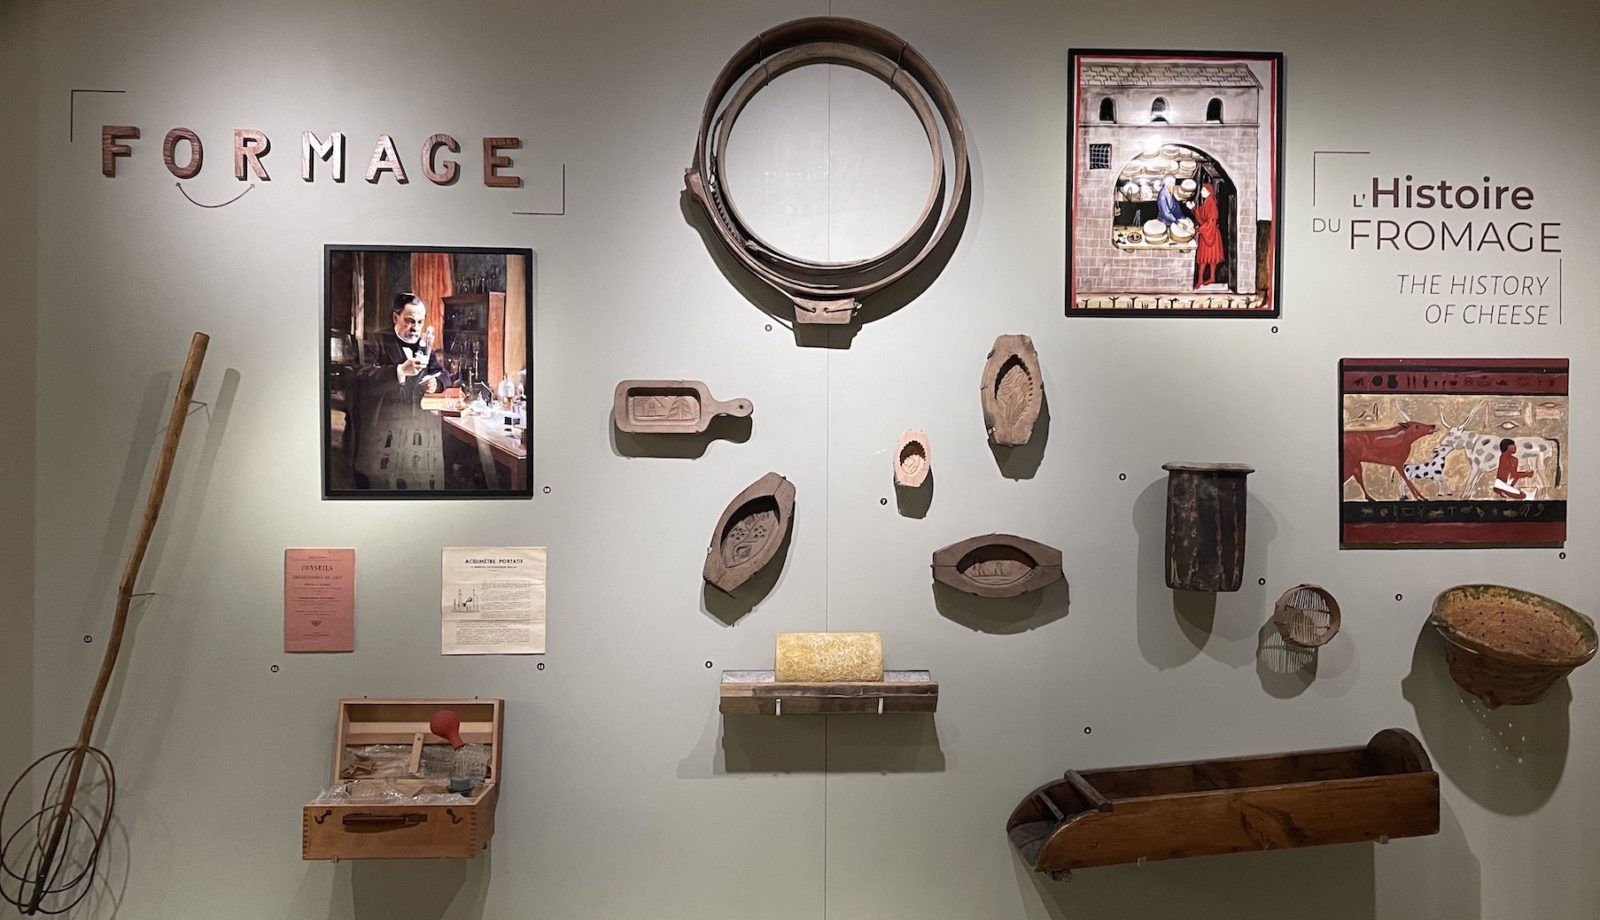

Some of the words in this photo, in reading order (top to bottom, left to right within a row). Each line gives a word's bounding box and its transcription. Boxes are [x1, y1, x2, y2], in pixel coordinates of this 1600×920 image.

[101, 125, 525, 188] FORMAGE
[1312, 217, 1341, 233] DU
[1350, 219, 1562, 253] FROMAGE
[1397, 274, 1442, 295] THE
[1450, 275, 1550, 296] HISTORY
[1425, 303, 1456, 324] OF
[1462, 304, 1550, 325] CHEESE
